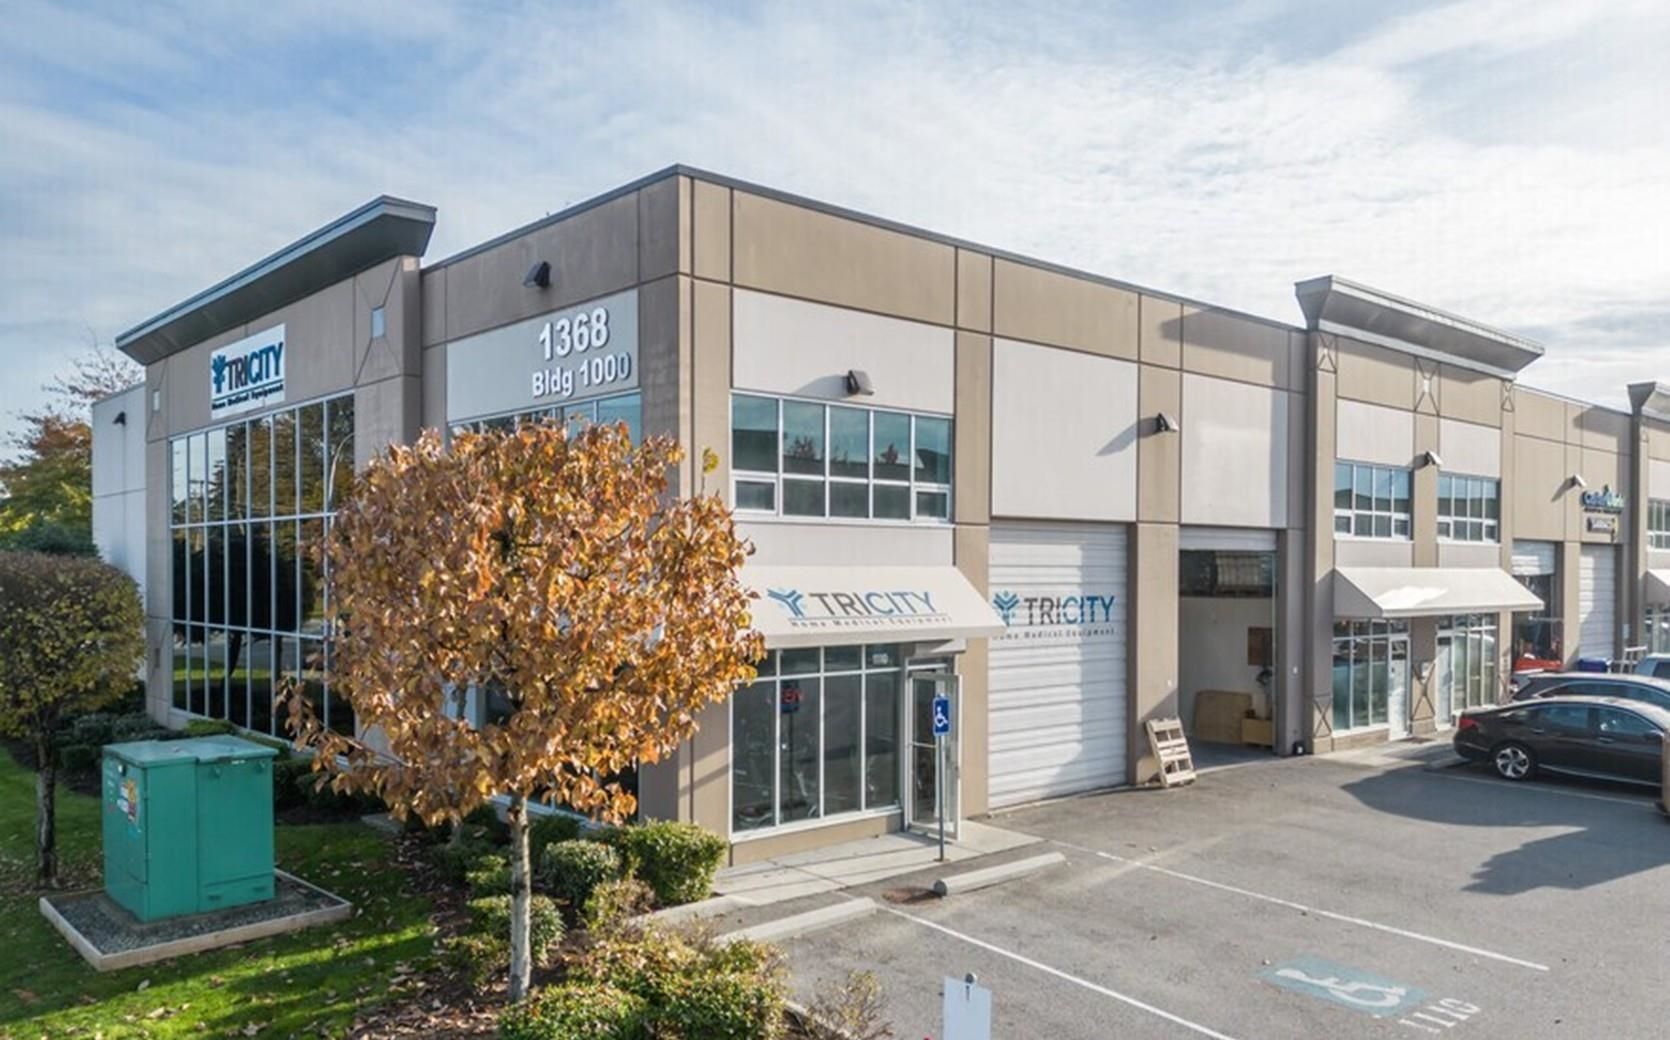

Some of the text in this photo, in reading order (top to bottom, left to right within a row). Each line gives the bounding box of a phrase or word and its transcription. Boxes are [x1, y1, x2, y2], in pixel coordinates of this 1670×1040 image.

[539, 307, 609, 360] 1368
[225, 341, 283, 390] TRICITY
[532, 352, 631, 397] Bldg 1000
[808, 591, 936, 616] TRICITY
[1024, 595, 1115, 625] TRICITY
